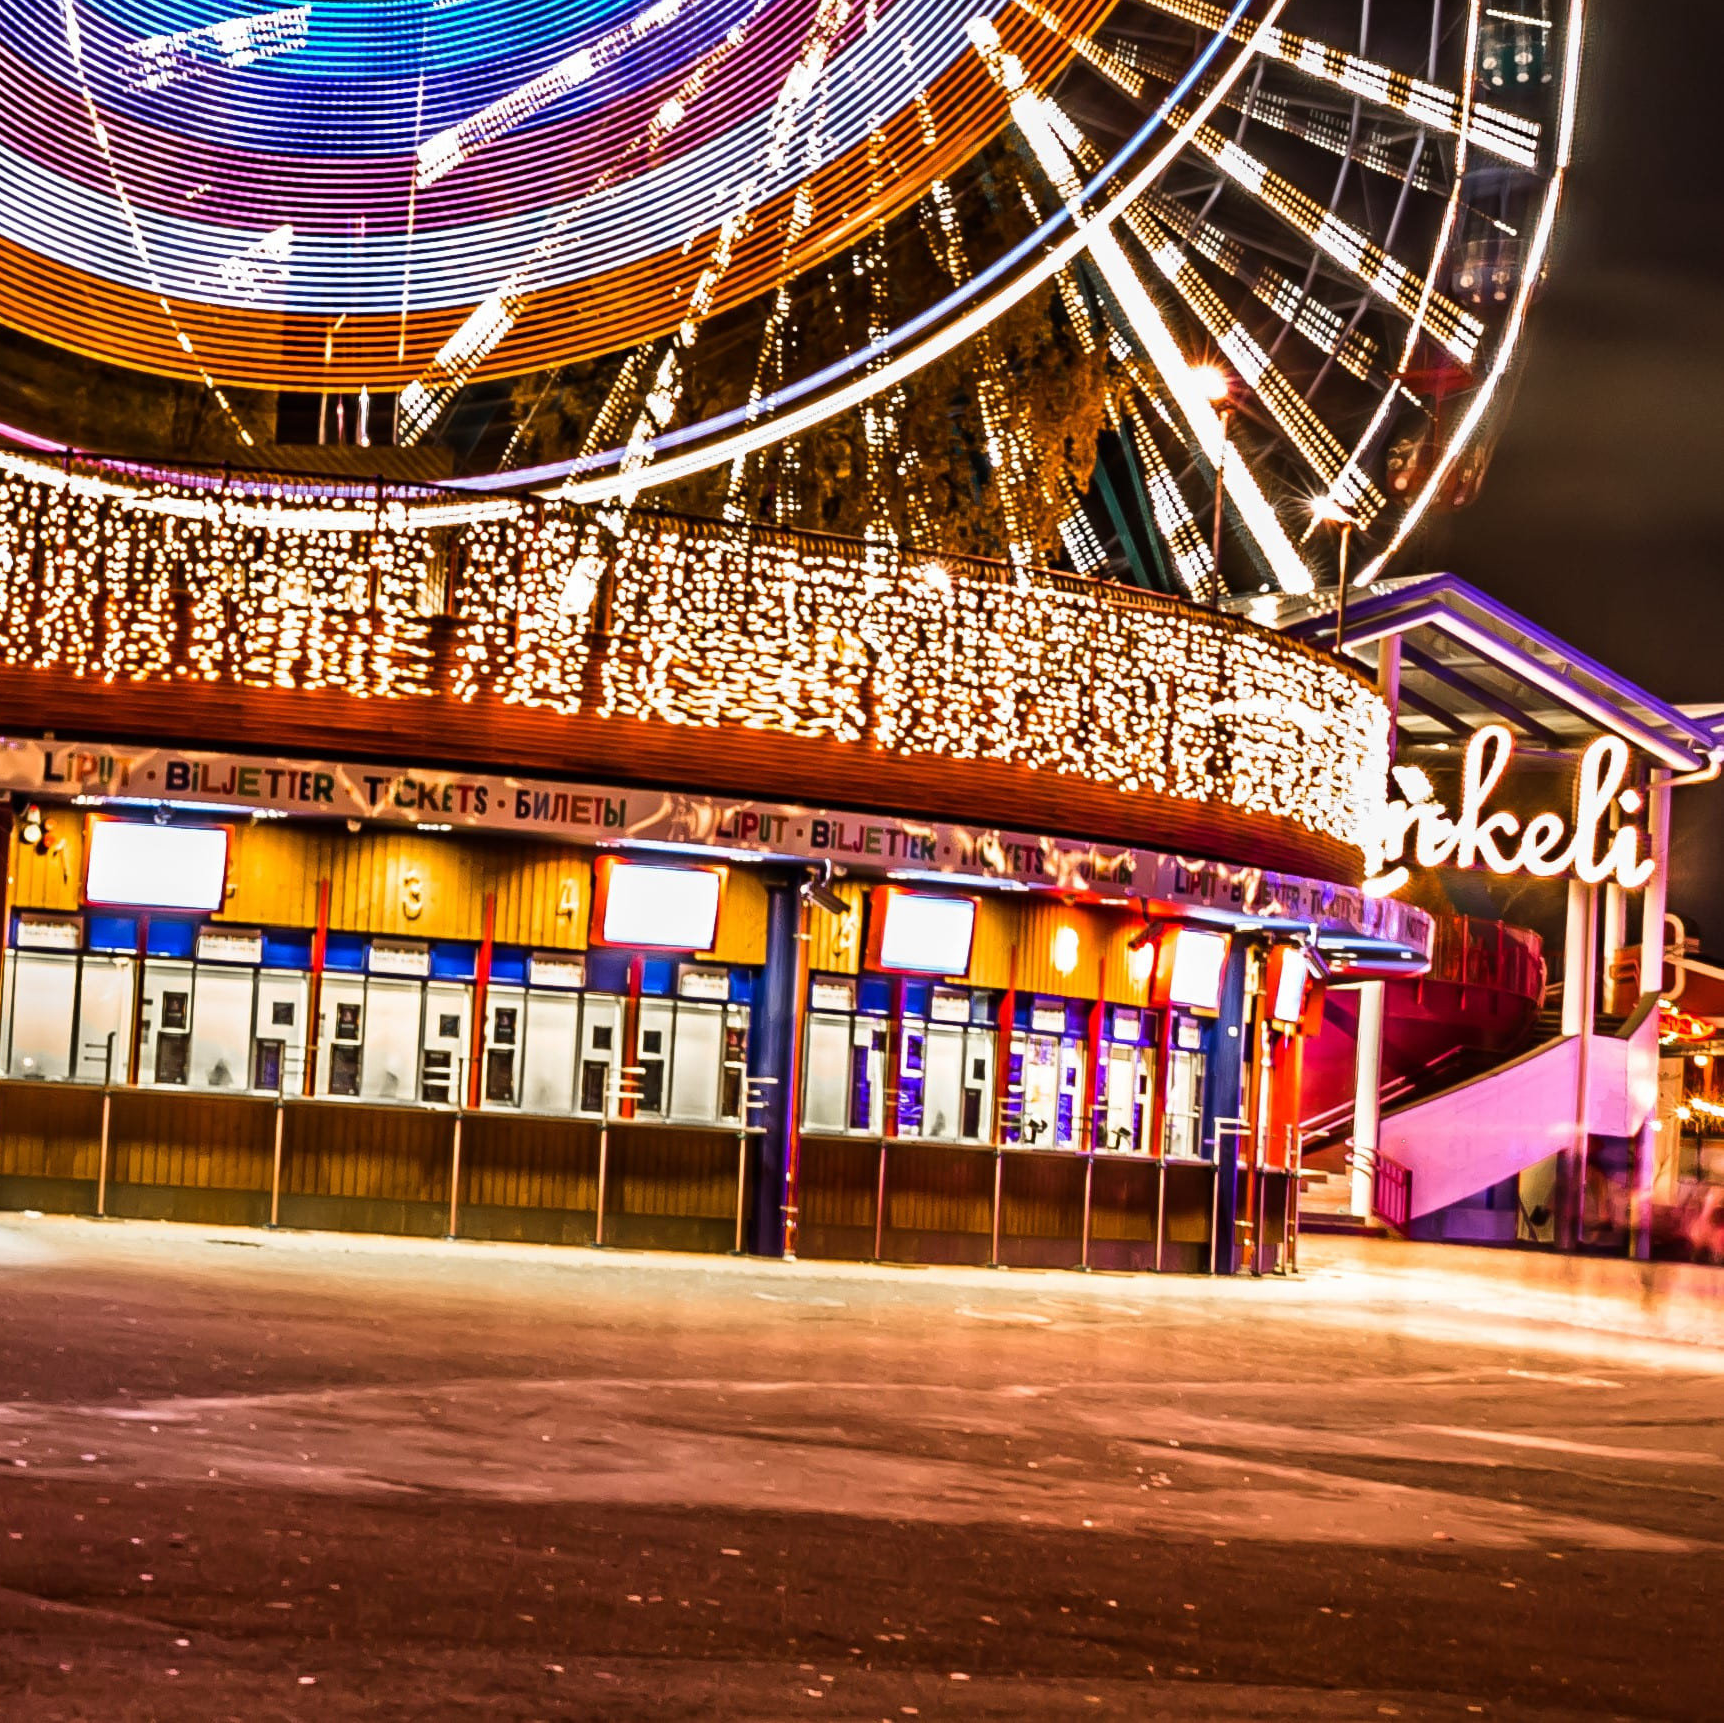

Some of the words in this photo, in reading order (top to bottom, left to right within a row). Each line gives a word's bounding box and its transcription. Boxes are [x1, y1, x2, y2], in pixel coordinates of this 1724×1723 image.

[515, 789, 626, 828] БИЛЕТЫ
[401, 868, 424, 921] 3
[556, 877, 580, 925] 4
